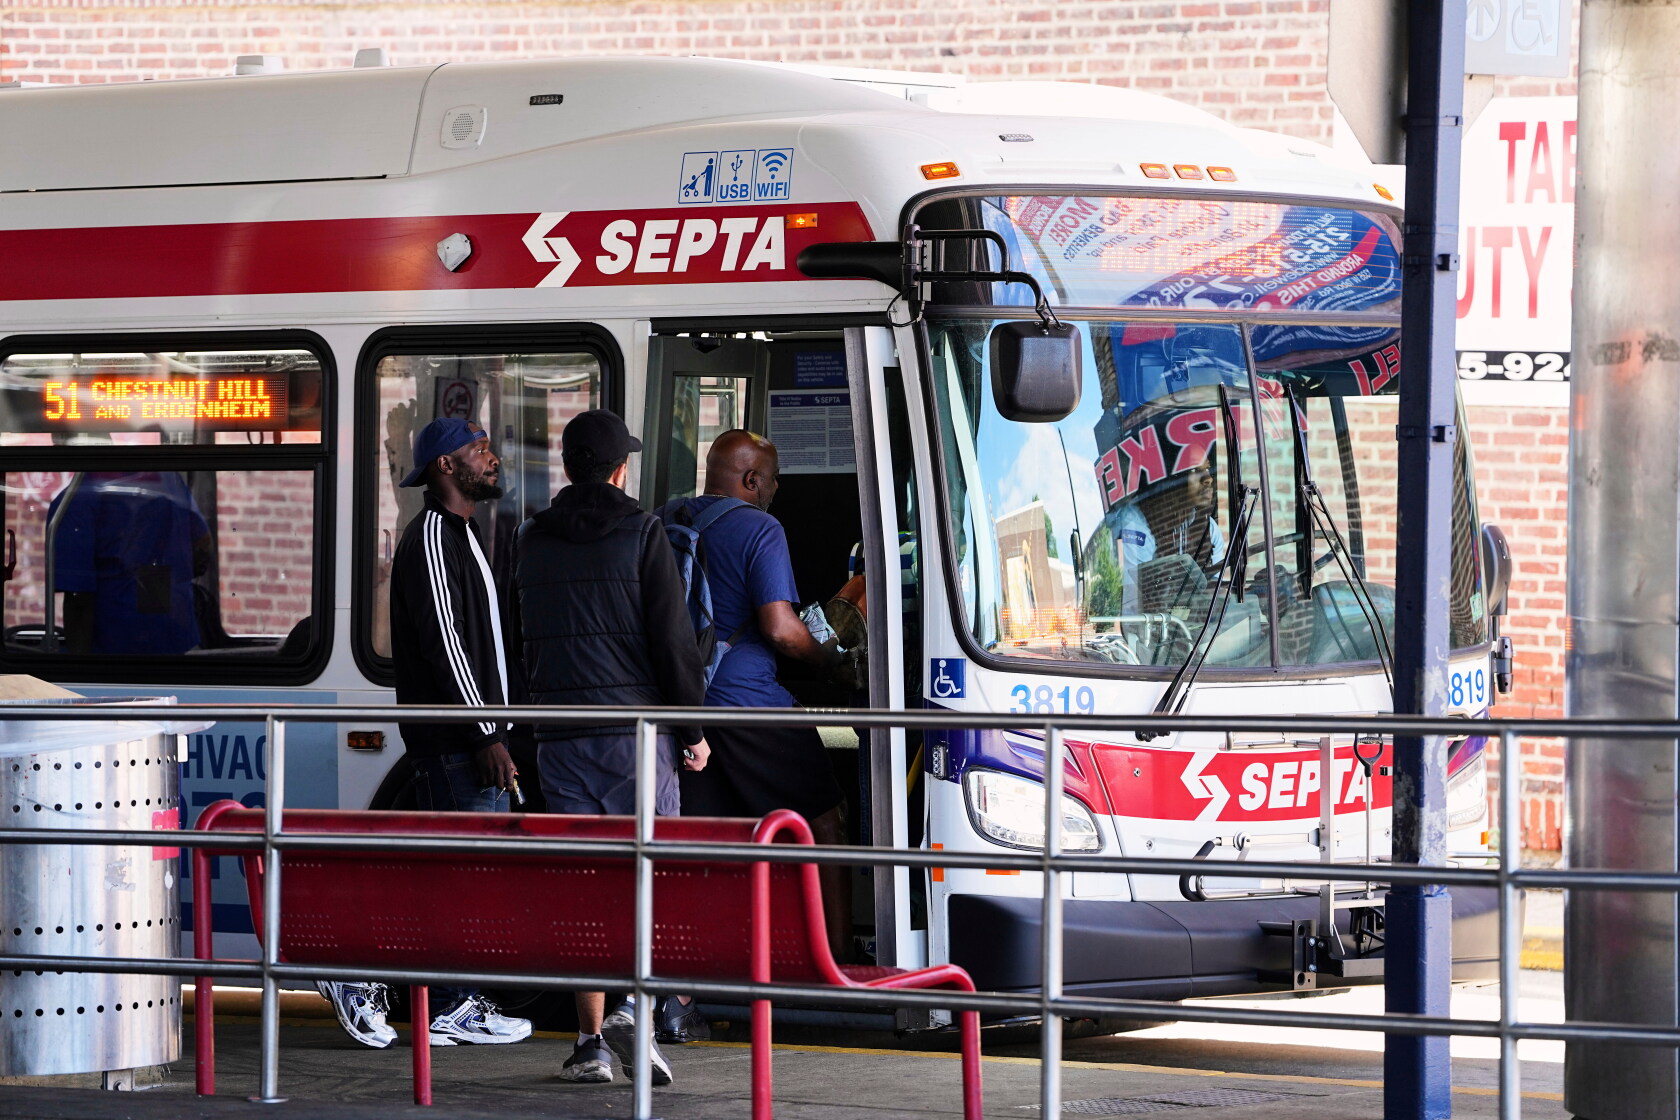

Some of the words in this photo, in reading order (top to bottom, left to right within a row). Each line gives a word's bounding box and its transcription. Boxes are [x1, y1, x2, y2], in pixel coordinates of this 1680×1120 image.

[719, 183, 749, 199] USB
[757, 181, 788, 199] WIFI
[595, 216, 786, 275] SEPTA
[1458, 352, 1570, 381] 5-92
[46, 382, 81, 419] 51
[91, 380, 210, 401] CHESTNUT
[218, 379, 271, 400] HILL
[95, 404, 131, 419] AND
[141, 401, 271, 418] ERDENHEIM
[820, 396, 840, 404] SEPTA
[1010, 684, 1095, 715] 3819
[1447, 668, 1485, 707] 819
[1238, 757, 1373, 811] SEPTA
